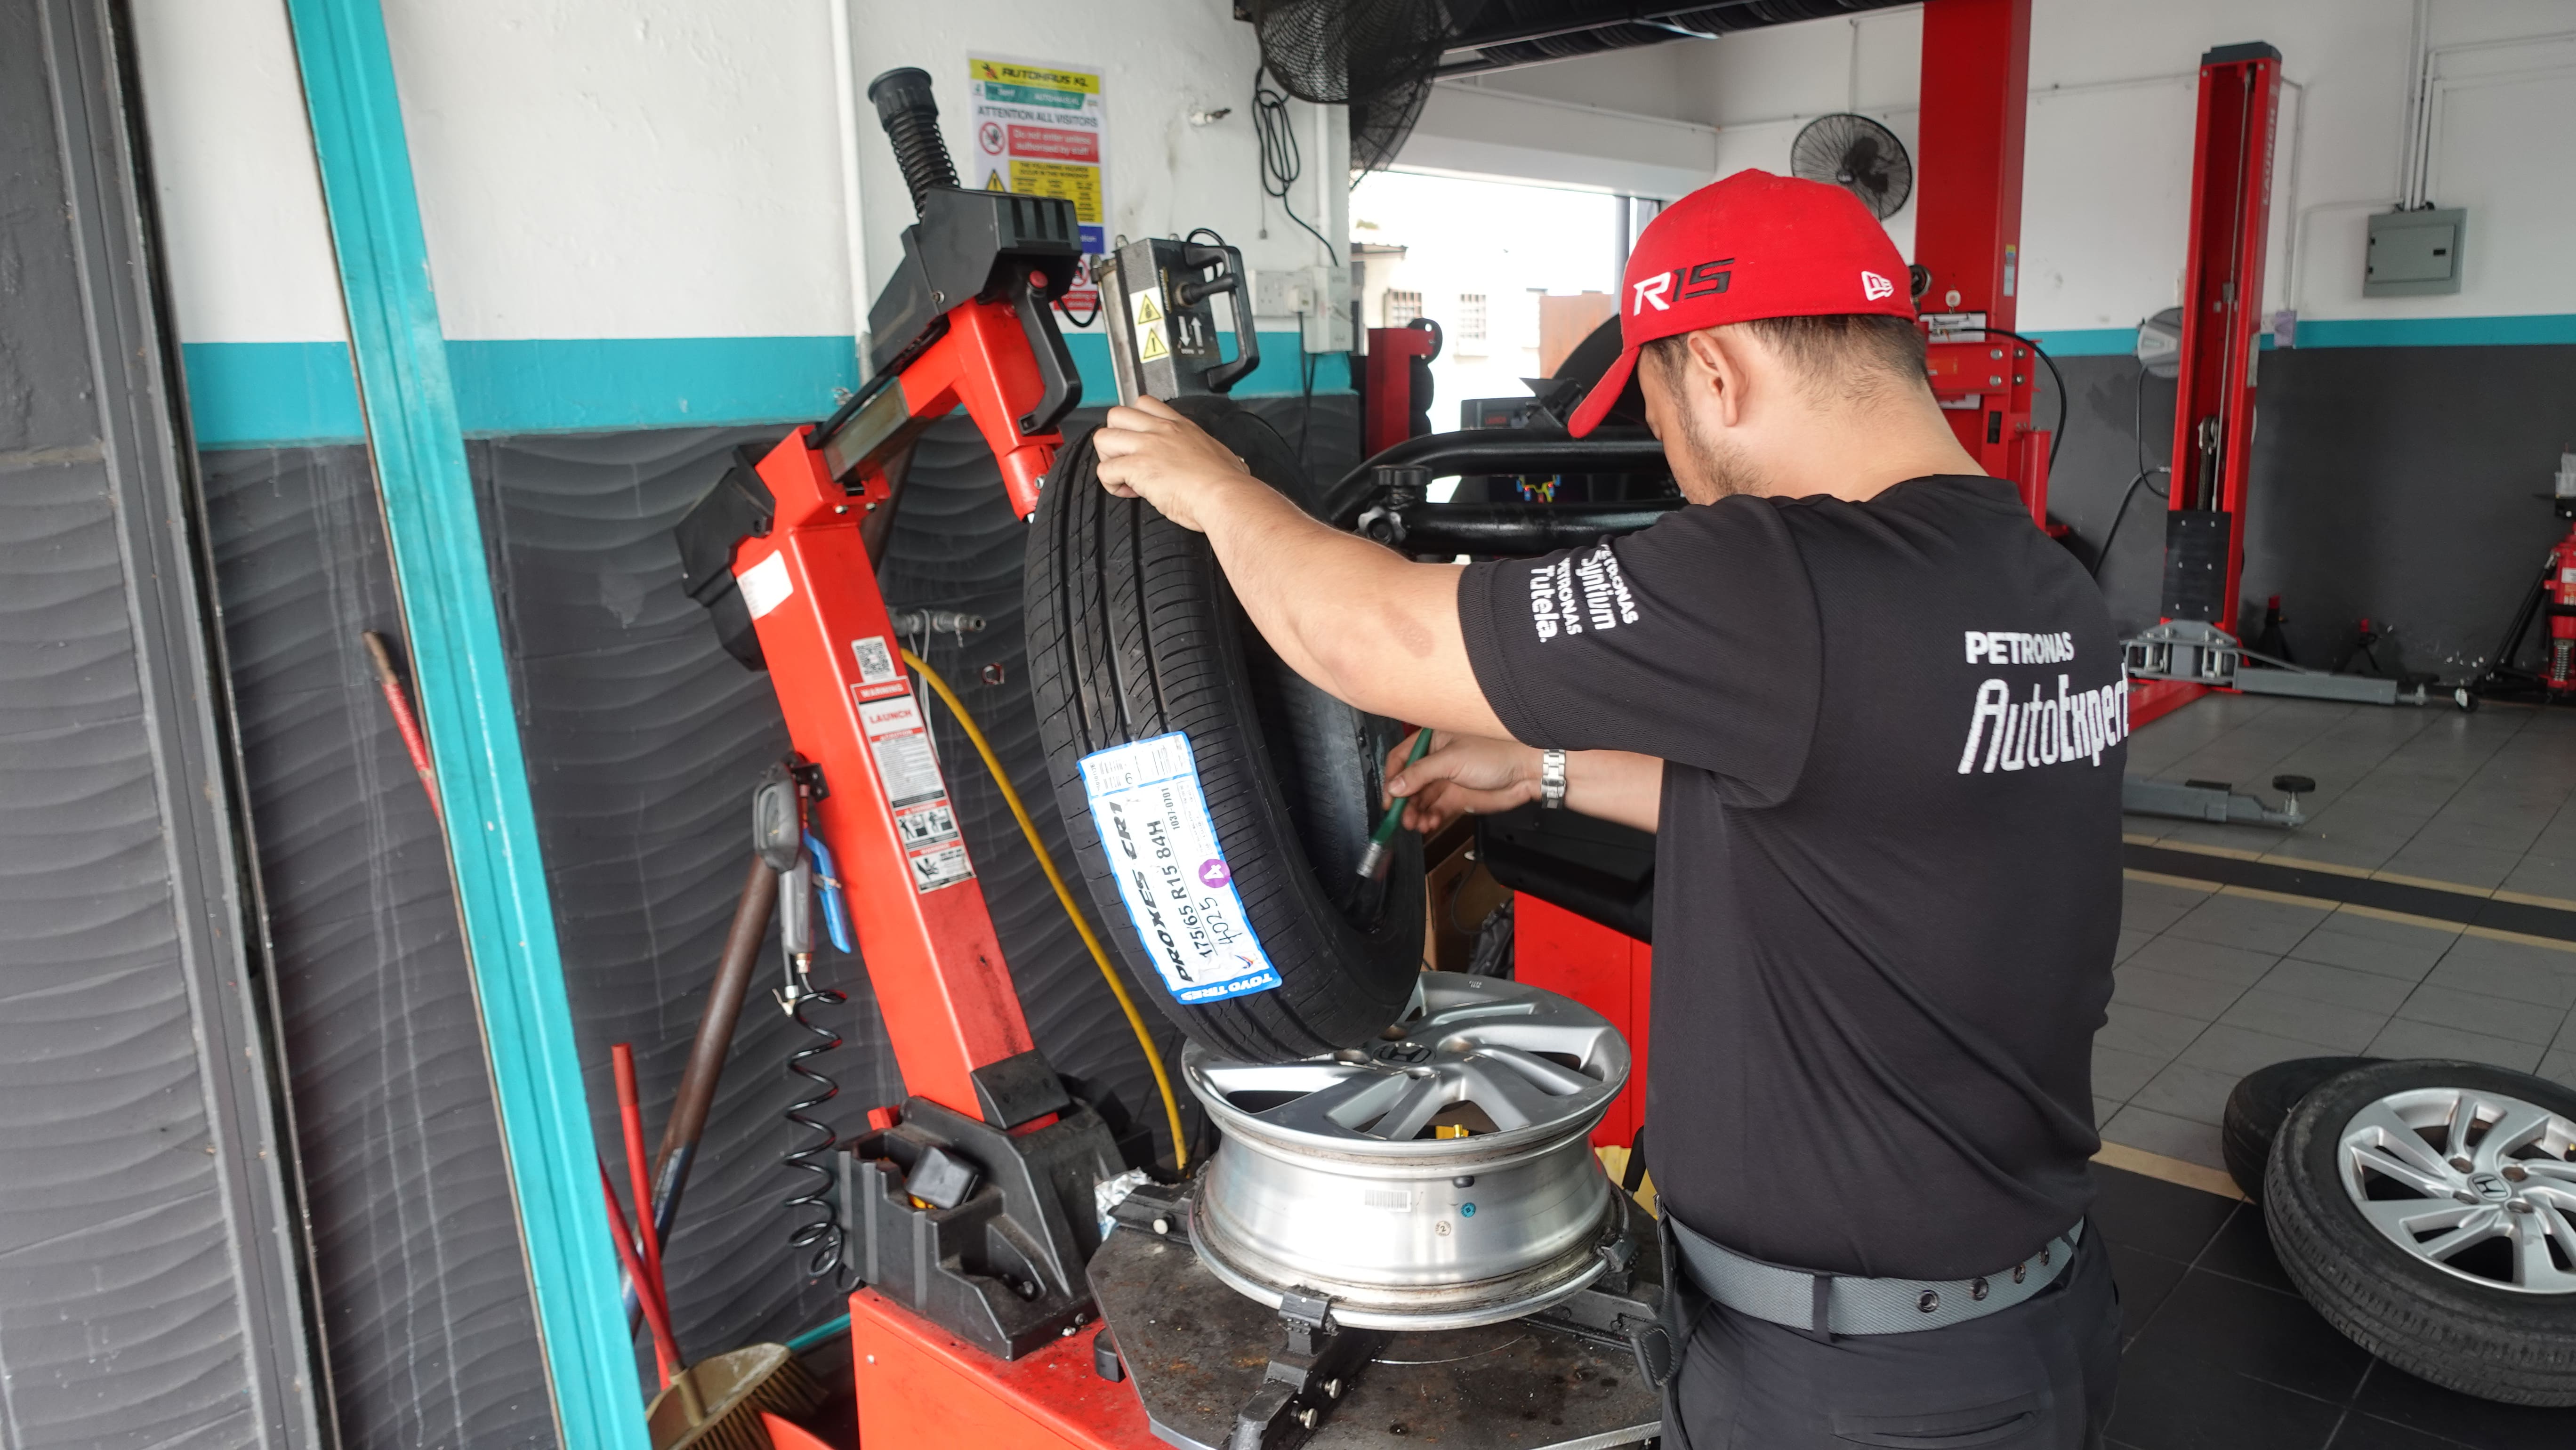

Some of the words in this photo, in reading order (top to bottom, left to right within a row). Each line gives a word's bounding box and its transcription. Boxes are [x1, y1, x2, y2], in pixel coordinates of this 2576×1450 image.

[1001, 67, 1071, 84] AUTOHAUS
[978, 105, 1034, 121] ATTENTION
[1037, 111, 1054, 123] ALL
[1054, 113, 1098, 128] VISITORS
[1013, 129, 1025, 138] Do
[1028, 131, 1041, 139] not
[1044, 132, 1063, 141] enter
[1575, 549, 1617, 630] Syntium
[1964, 631, 2075, 665] PETRONAS
[860, 683, 904, 698] WARNING
[868, 709, 912, 724] LAUNCH
[1161, 788, 1180, 830] 1037-0701
[1146, 820, 1172, 859] 84H
[1161, 865, 1187, 900] R15
[1132, 869, 1195, 983] PROXES
[1178, 905, 1213, 958] 175/65
[1199, 897, 1243, 945] 4025
[1180, 985, 1228, 1001] TIRES
[1228, 973, 1273, 992] TOYO
